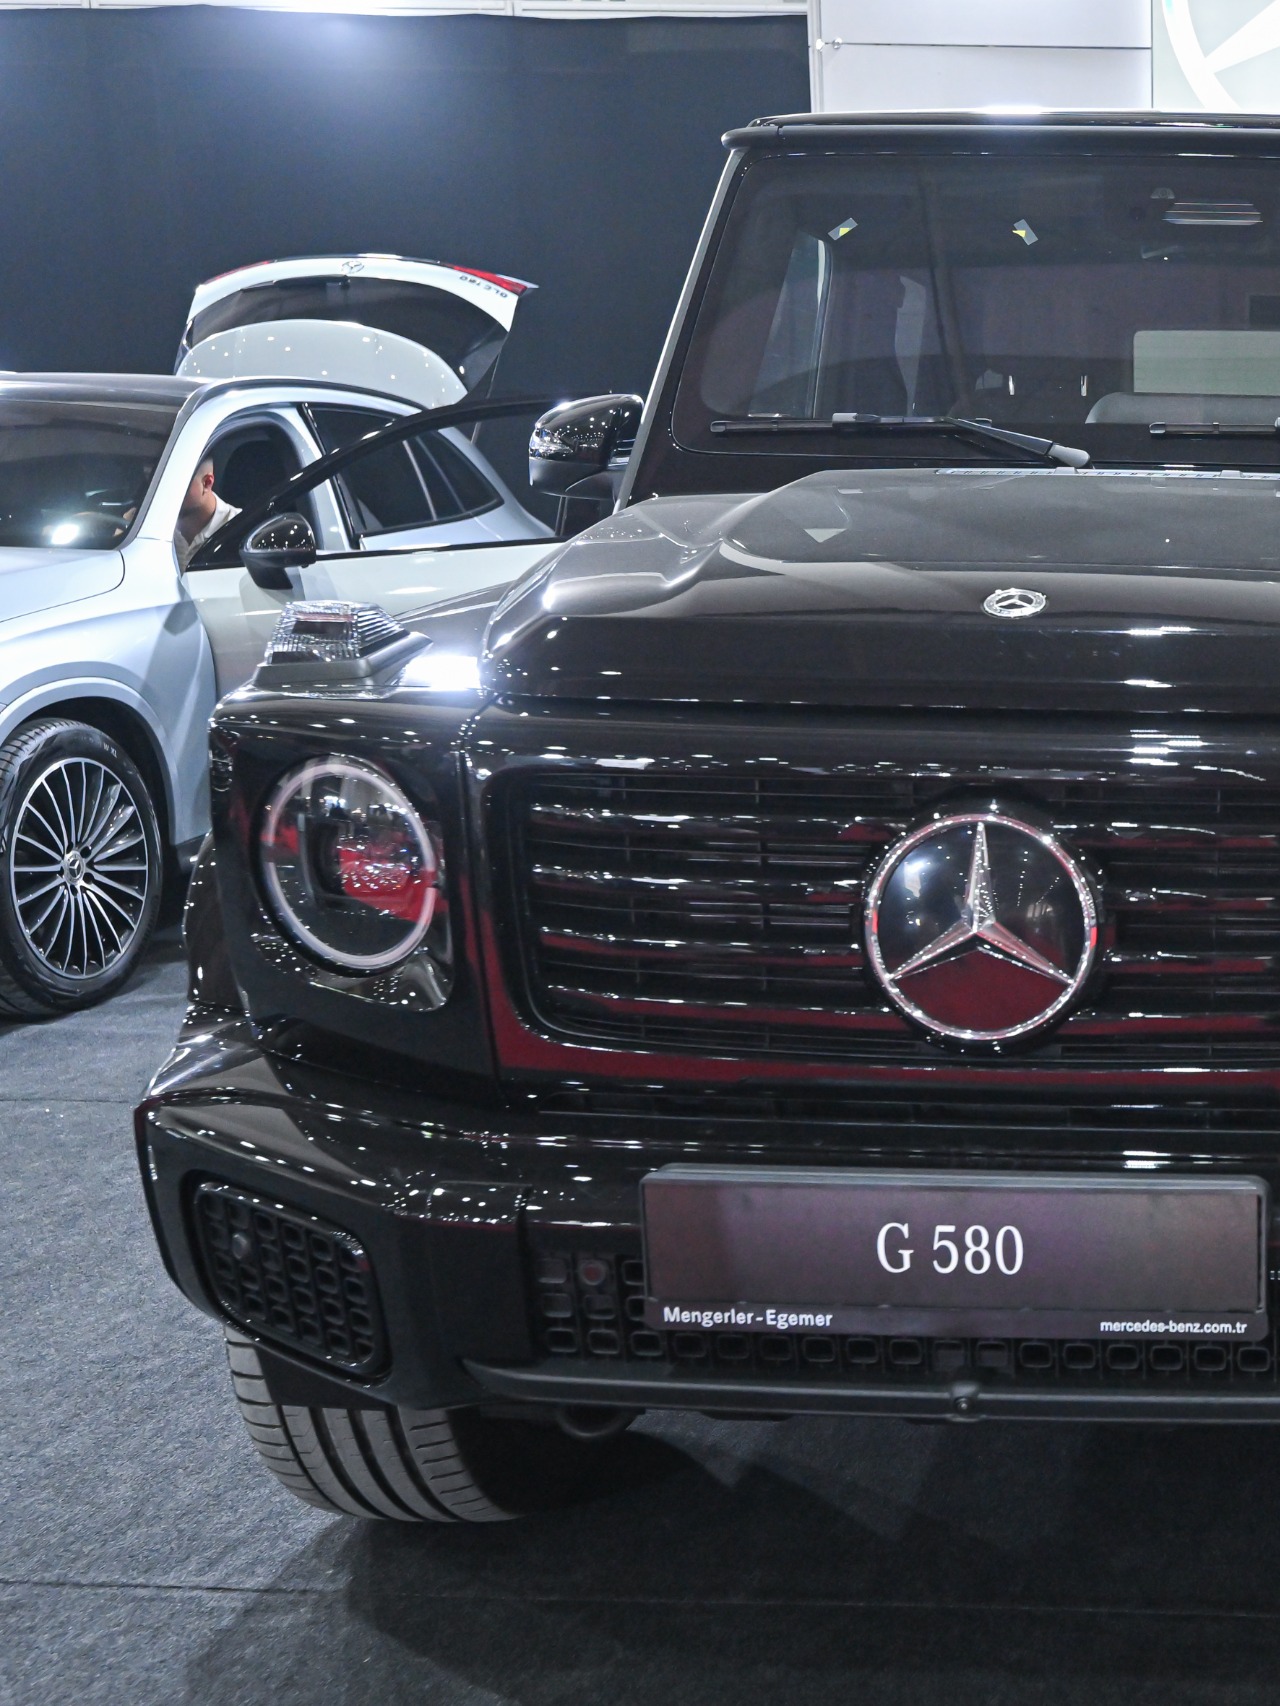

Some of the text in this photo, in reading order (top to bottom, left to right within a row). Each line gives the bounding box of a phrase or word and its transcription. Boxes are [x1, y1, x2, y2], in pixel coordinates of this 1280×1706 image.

[877, 1222, 1024, 1275] G 580
[1100, 1320, 1247, 1333] mercedes-benz.com.tr
